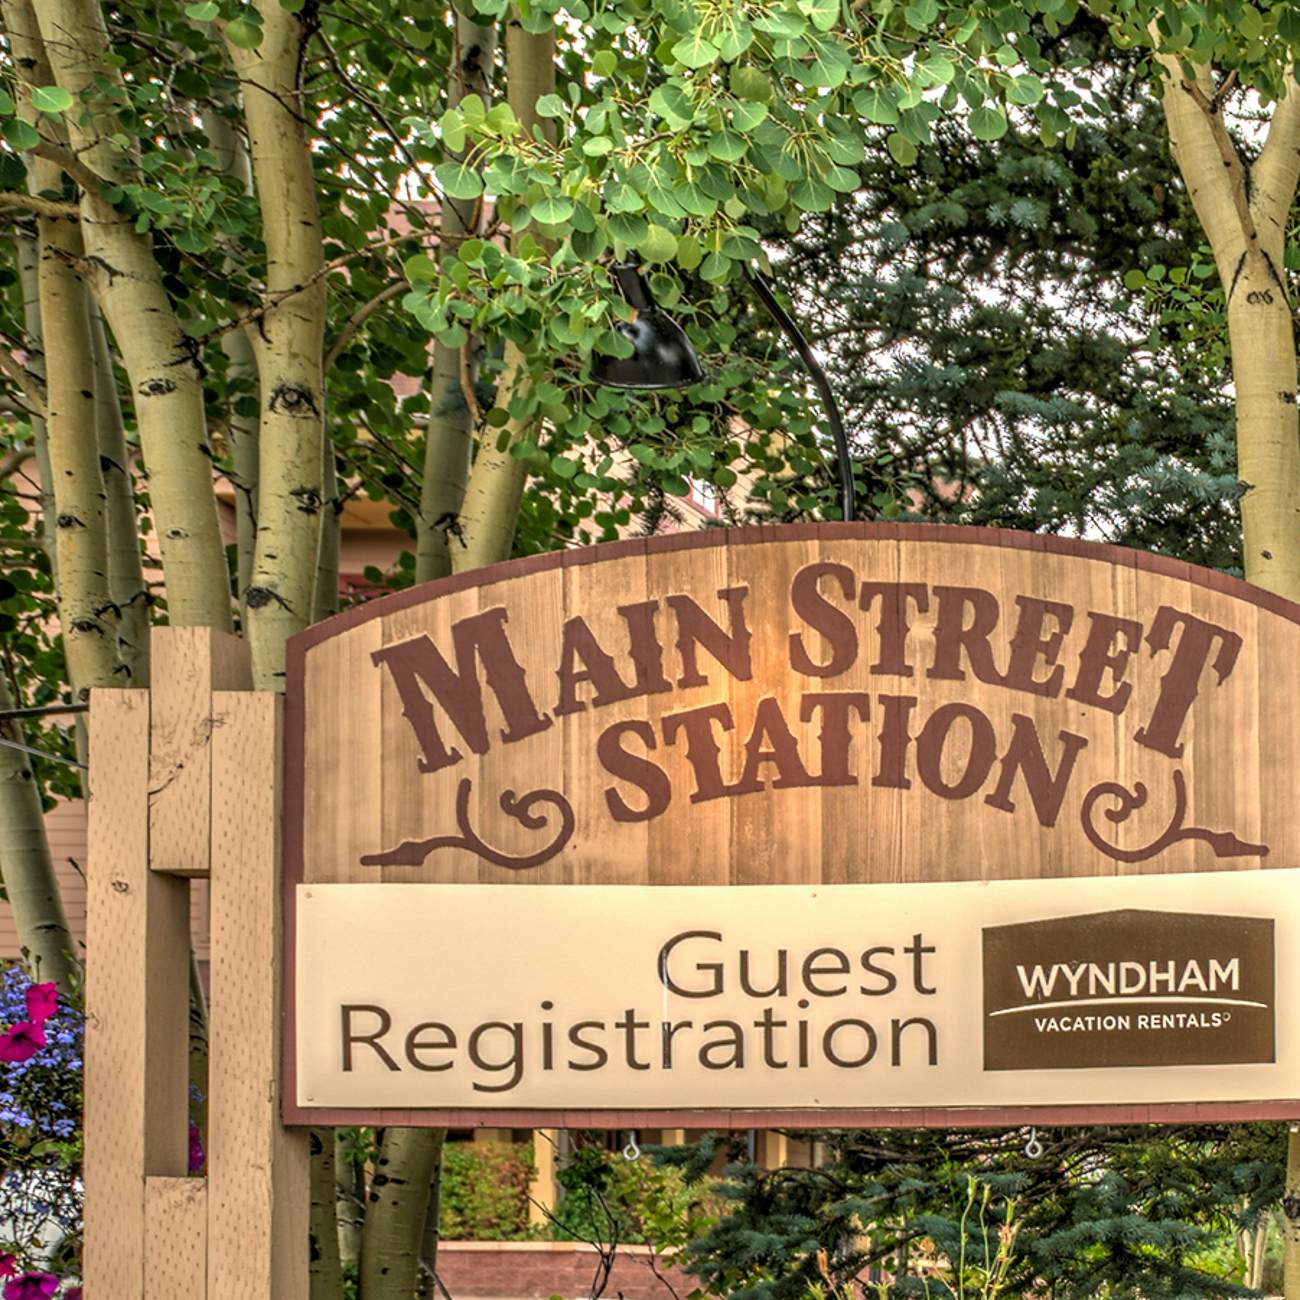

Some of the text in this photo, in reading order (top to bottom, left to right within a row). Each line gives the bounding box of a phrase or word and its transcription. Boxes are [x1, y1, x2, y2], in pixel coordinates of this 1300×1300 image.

[370, 561, 1244, 775] MAIN STREET
[597, 691, 1089, 828] STATION
[656, 930, 937, 999] Guest
[1016, 958, 1240, 998] WYNDHAM
[339, 998, 939, 1094] Registration
[1034, 1011, 1223, 1032] VACATION RENTALS
